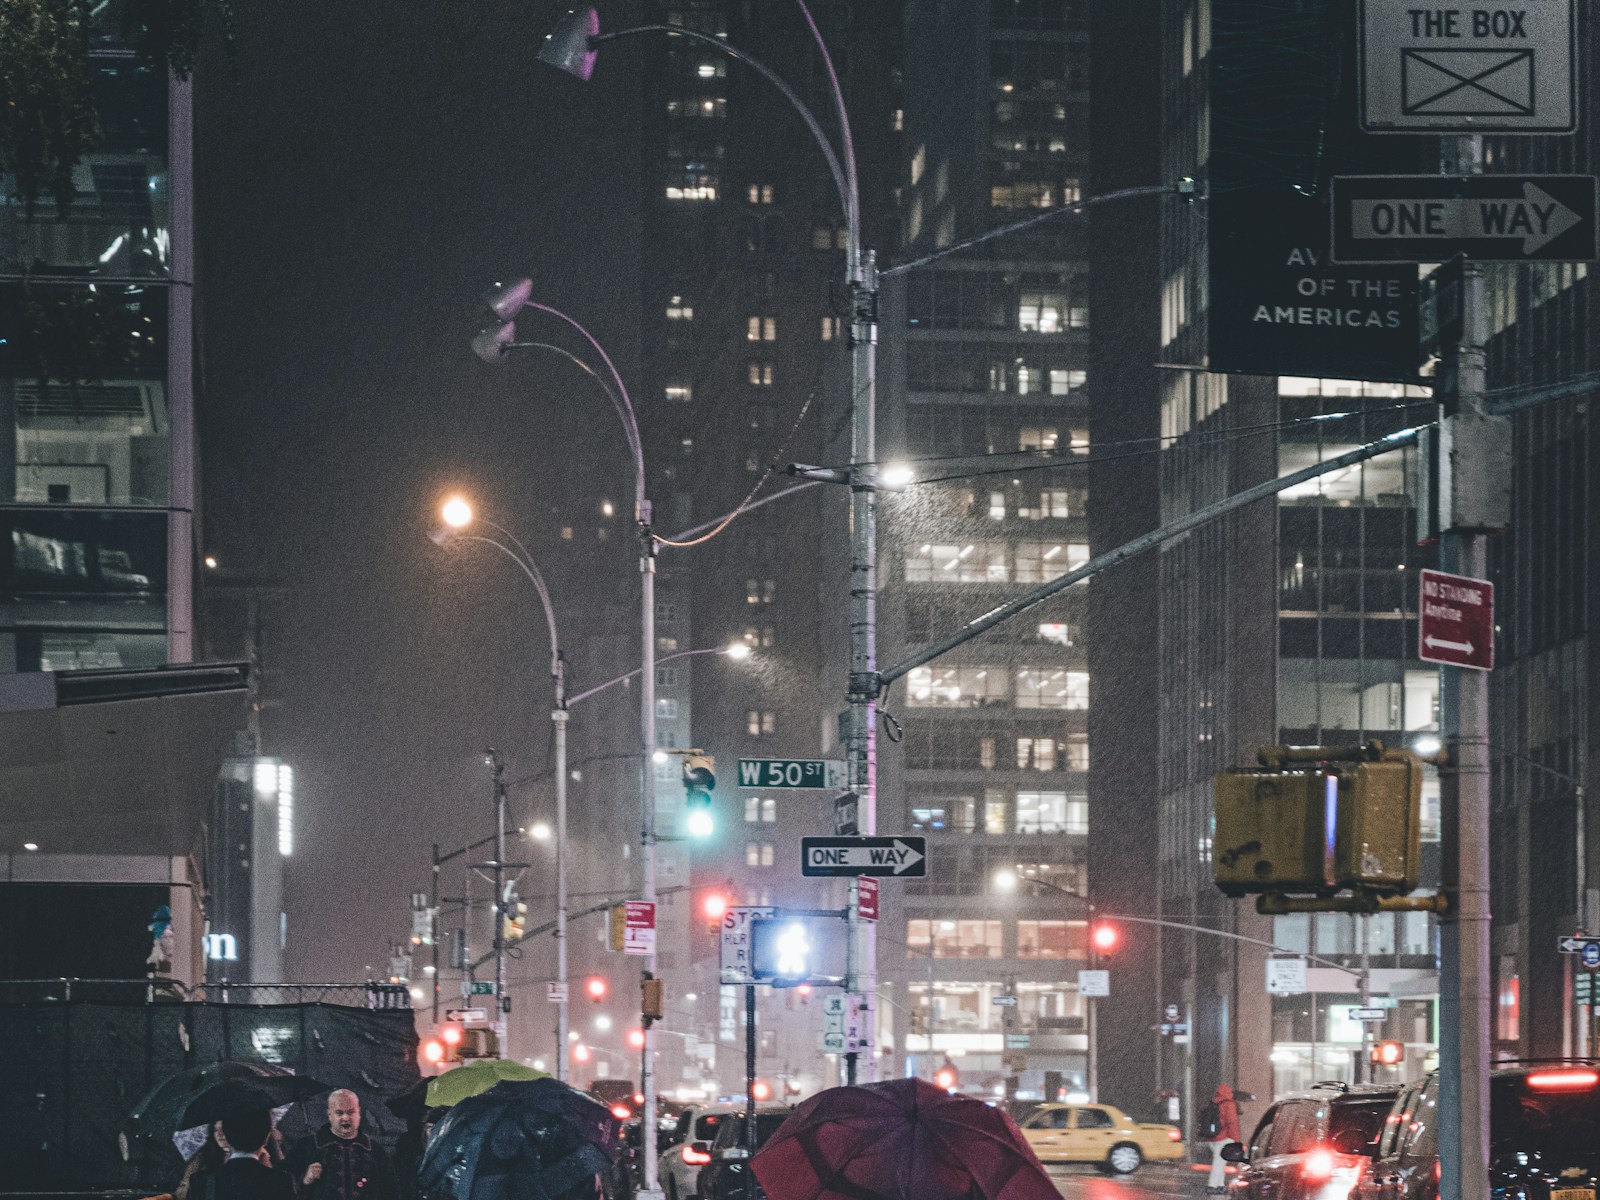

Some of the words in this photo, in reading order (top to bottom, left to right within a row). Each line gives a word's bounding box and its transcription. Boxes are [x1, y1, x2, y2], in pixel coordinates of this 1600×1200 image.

[1408, 9, 1461, 38] THE
[1472, 9, 1527, 38] BOX
[1371, 203, 1446, 236] ONE
[1480, 203, 1556, 236] WAY
[1297, 278, 1336, 296] OF
[1347, 280, 1400, 298] THE
[1253, 304, 1401, 328] AMERICAS
[741, 762, 761, 785] W
[768, 762, 802, 786] 50
[805, 763, 822, 776] ST
[812, 849, 849, 864] ONE
[870, 849, 909, 864] WAY
